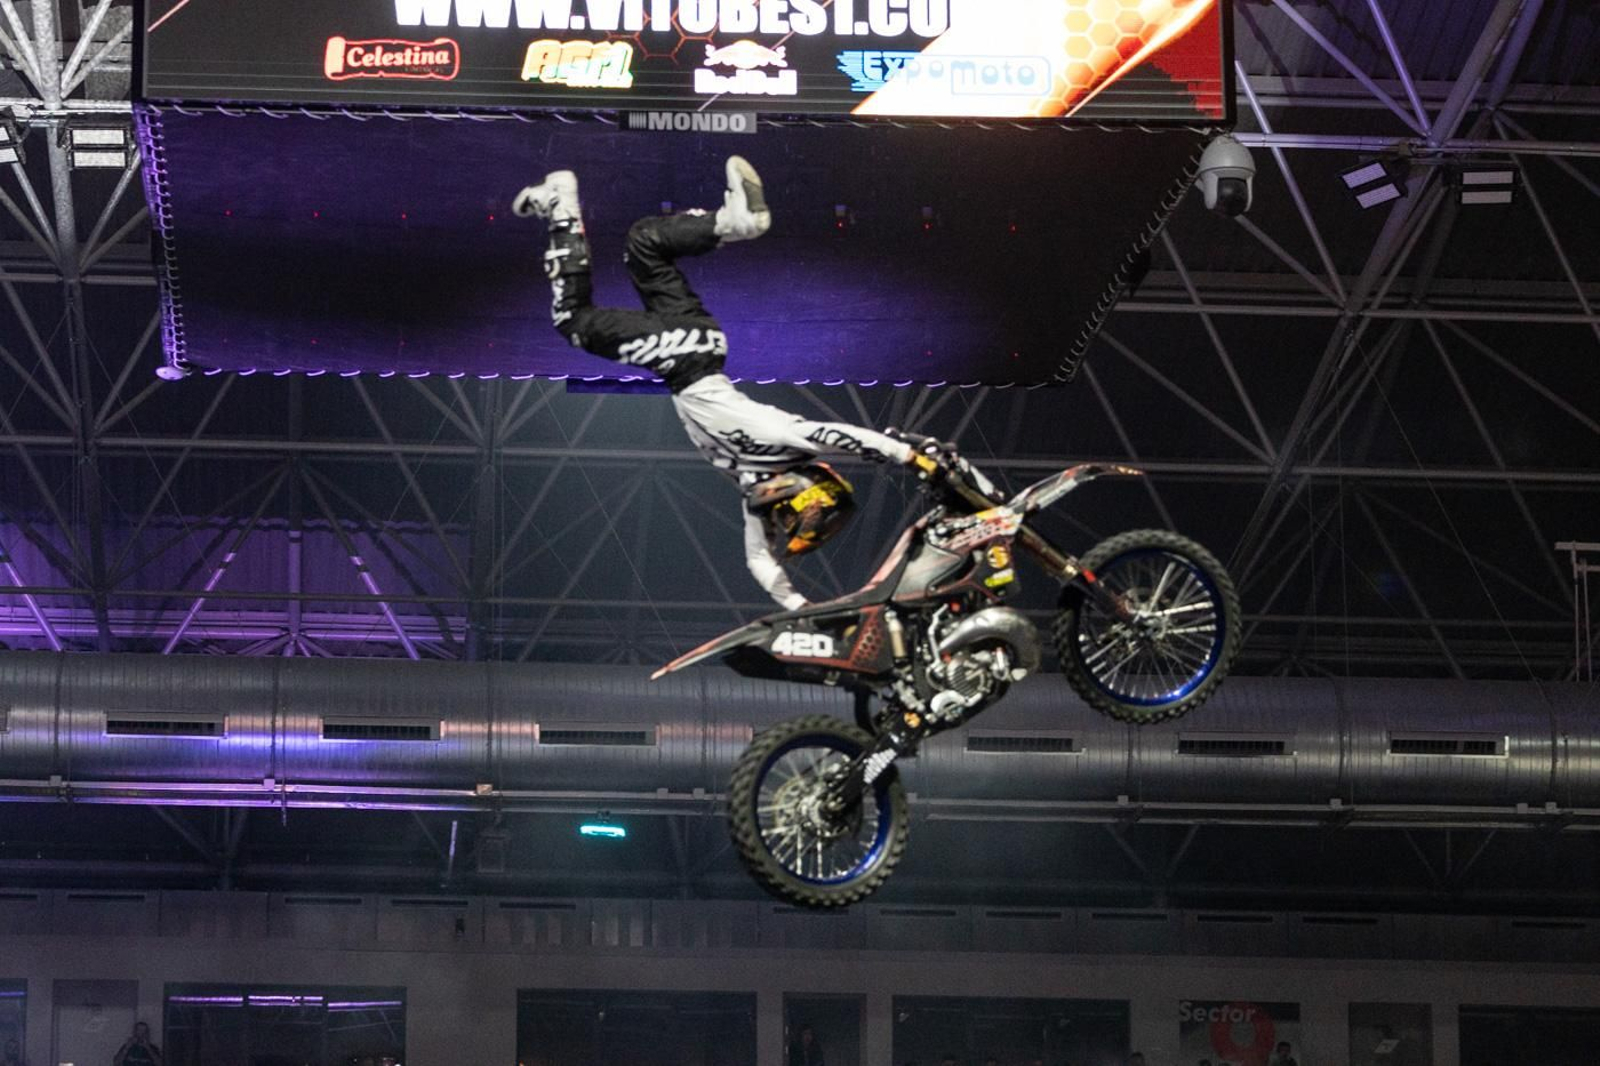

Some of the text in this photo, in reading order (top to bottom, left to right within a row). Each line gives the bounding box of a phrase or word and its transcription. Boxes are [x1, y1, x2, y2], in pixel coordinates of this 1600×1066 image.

[347, 46, 450, 67] Celestina
[648, 112, 746, 132] MONDO
[771, 632, 834, 658] 420
[1179, 1002, 1256, 1023] Sector
